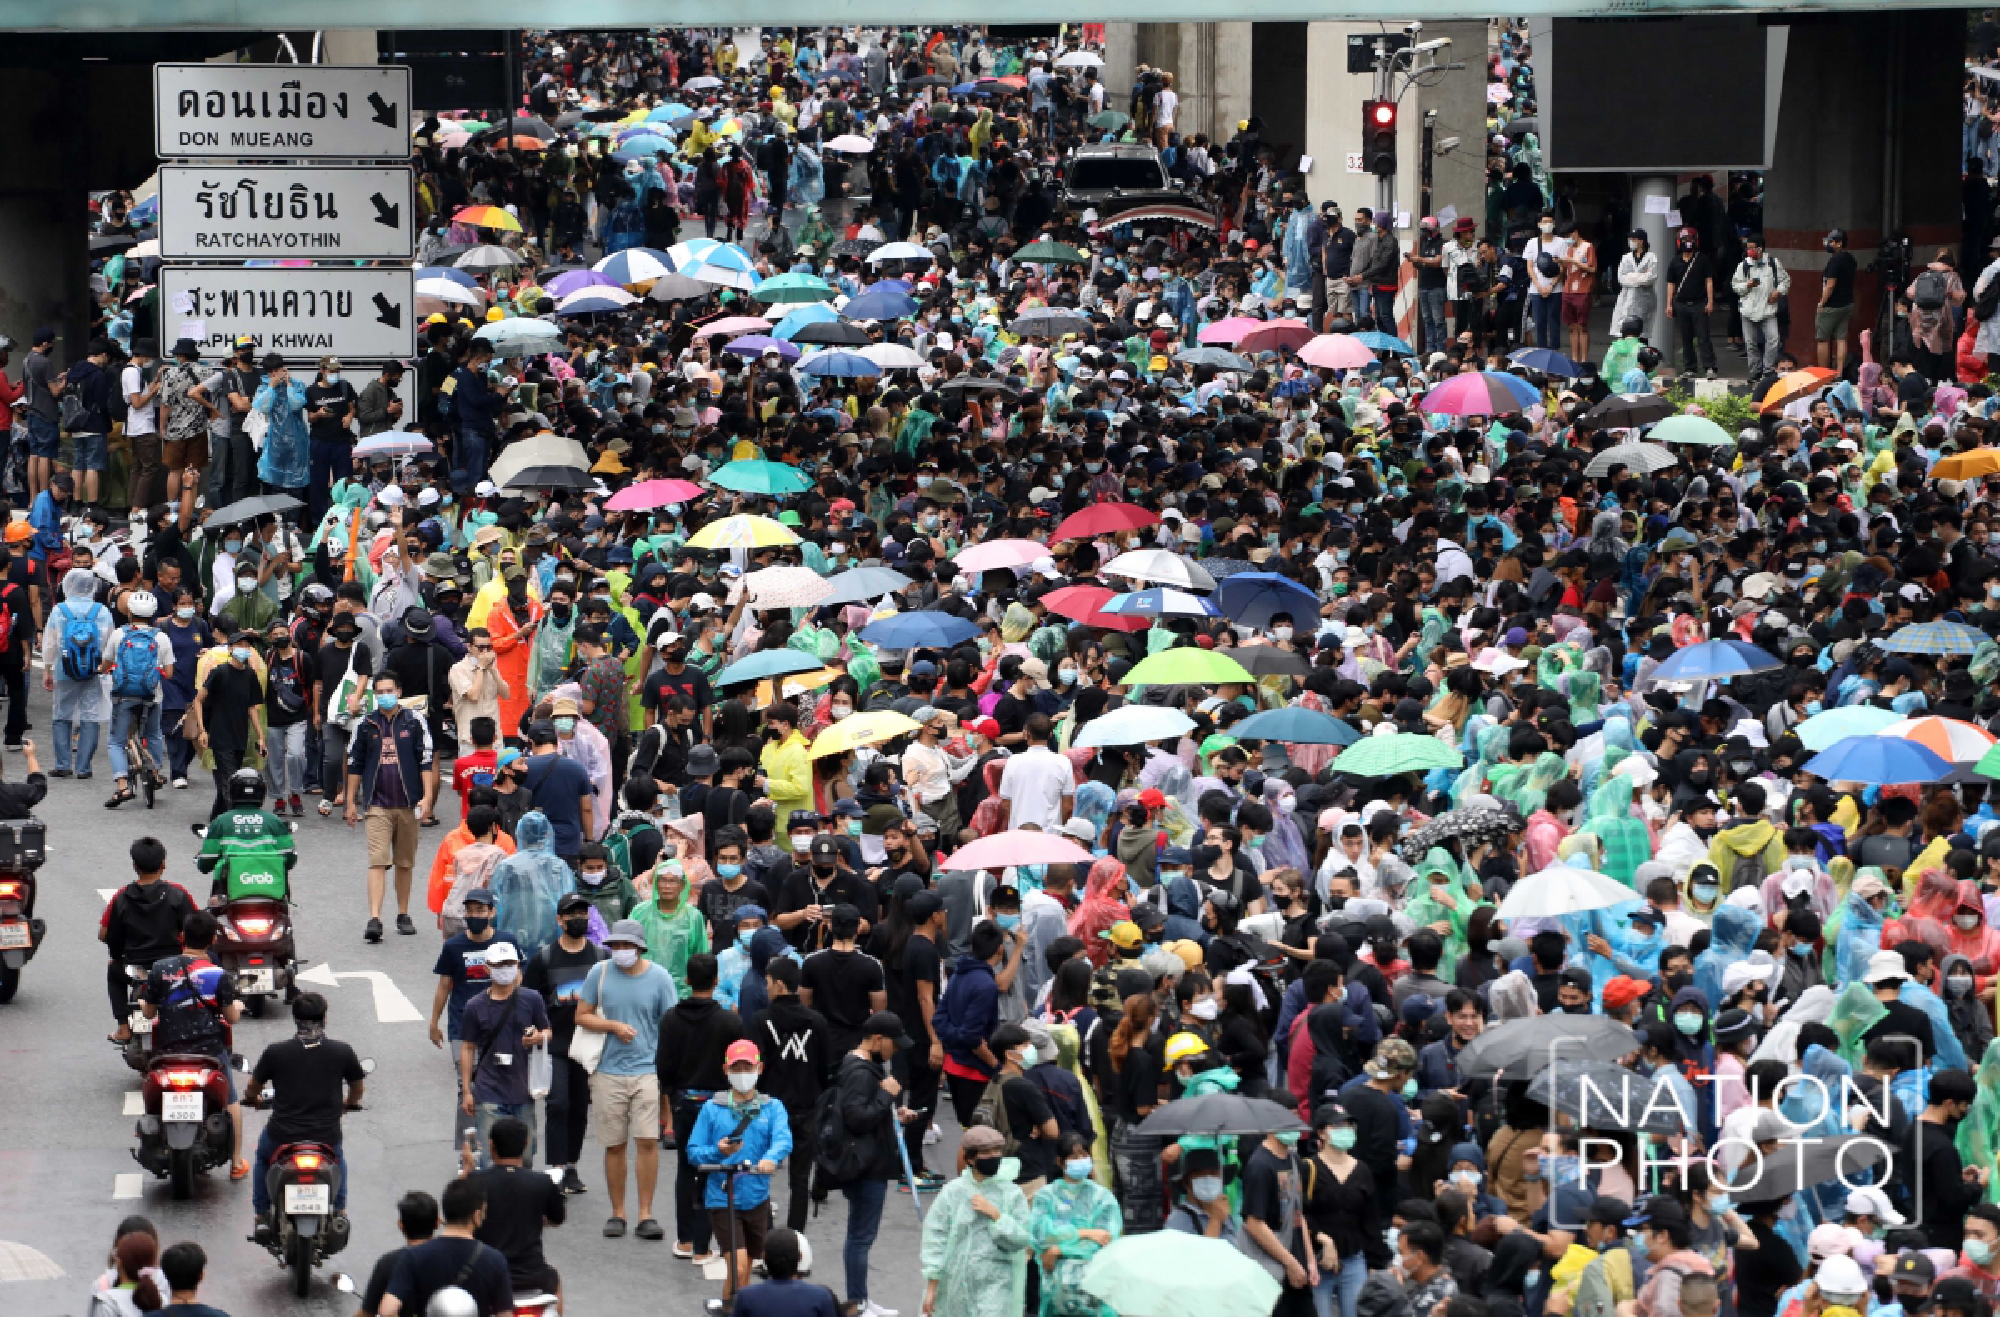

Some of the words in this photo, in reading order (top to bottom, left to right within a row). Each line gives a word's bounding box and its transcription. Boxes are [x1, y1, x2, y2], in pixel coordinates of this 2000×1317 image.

[178, 80, 348, 119] ดอนเมือง
[179, 132, 219, 146] DON
[231, 132, 313, 147] MUEANG
[196, 178, 339, 219] รัชโยธิน
[196, 233, 341, 248] RATCHAYOTHIN
[272, 333, 333, 348] KHWAI
[233, 813, 264, 825] Grab
[240, 870, 274, 885] Grab
